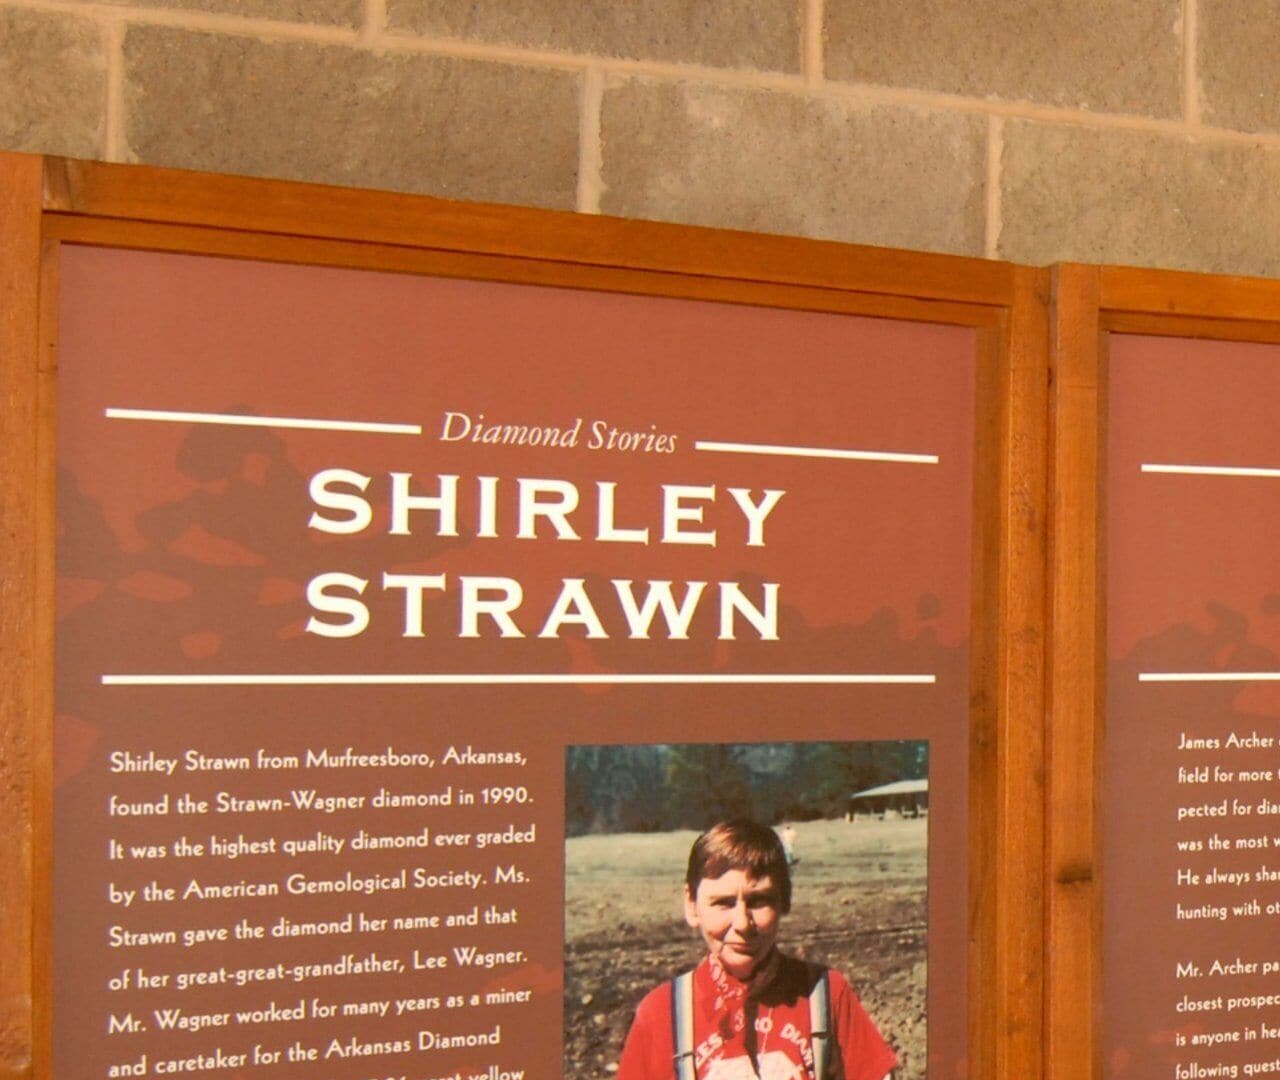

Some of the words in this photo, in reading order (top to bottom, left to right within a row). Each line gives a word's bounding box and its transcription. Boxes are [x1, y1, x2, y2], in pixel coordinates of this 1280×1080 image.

[440, 412, 581, 447] Diamond
[588, 421, 677, 453] Stories
[309, 469, 785, 546] SHIRLEY
[306, 572, 779, 640] STRAWN
[109, 750, 178, 775] Shirley
[184, 749, 250, 771] Strawn
[256, 748, 299, 769] from
[305, 746, 435, 768] Murfreesboro,
[441, 745, 527, 766] Arkansas,
[1177, 732, 1220, 749] James
[1224, 731, 1274, 748] Archer
[1177, 765, 1209, 783] field
[1213, 765, 1234, 782] for
[1238, 770, 1273, 781] more
[109, 793, 168, 816] found
[176, 793, 208, 814] the
[215, 789, 365, 813] Strawn-Wagner
[371, 785, 452, 808] diamond
[458, 789, 474, 805] in
[480, 786, 533, 804] 1990.
[1177, 799, 1227, 821] pected
[1232, 798, 1252, 815] for
[109, 838, 124, 859] It
[130, 845, 166, 858] was
[172, 836, 204, 857] the
[210, 834, 276, 859] highest
[281, 831, 345, 856] quality
[350, 827, 428, 850] diamond
[433, 833, 471, 846] ever
[475, 823, 536, 848] graded
[108, 882, 136, 907] by
[142, 880, 175, 901] the
[181, 879, 278, 900] American
[285, 868, 406, 894] Gemological
[412, 867, 487, 889] Society.
[494, 864, 530, 884] Ms.
[108, 925, 176, 947] Strawn
[182, 928, 228, 946] gave
[233, 918, 265, 939] the
[270, 912, 352, 937] diamond
[358, 912, 388, 932] her
[392, 915, 440, 930] name
[445, 905, 478, 927] and
[483, 905, 517, 924] that
[107, 968, 130, 990] of
[136, 968, 170, 988] her
[176, 952, 405, 990] great-great-grandfather,
[413, 949, 447, 969] Lee
[452, 946, 527, 968] Wagner.
[107, 1013, 146, 1034] Mr.
[153, 1008, 230, 1032] Wagner
[235, 999, 305, 1023] worked
[311, 997, 337, 1018] for
[342, 1000, 390, 1017] many
[394, 996, 440, 1015] years
[445, 995, 464, 1008] as
[469, 994, 480, 1006] a
[485, 987, 532, 1005] miner
